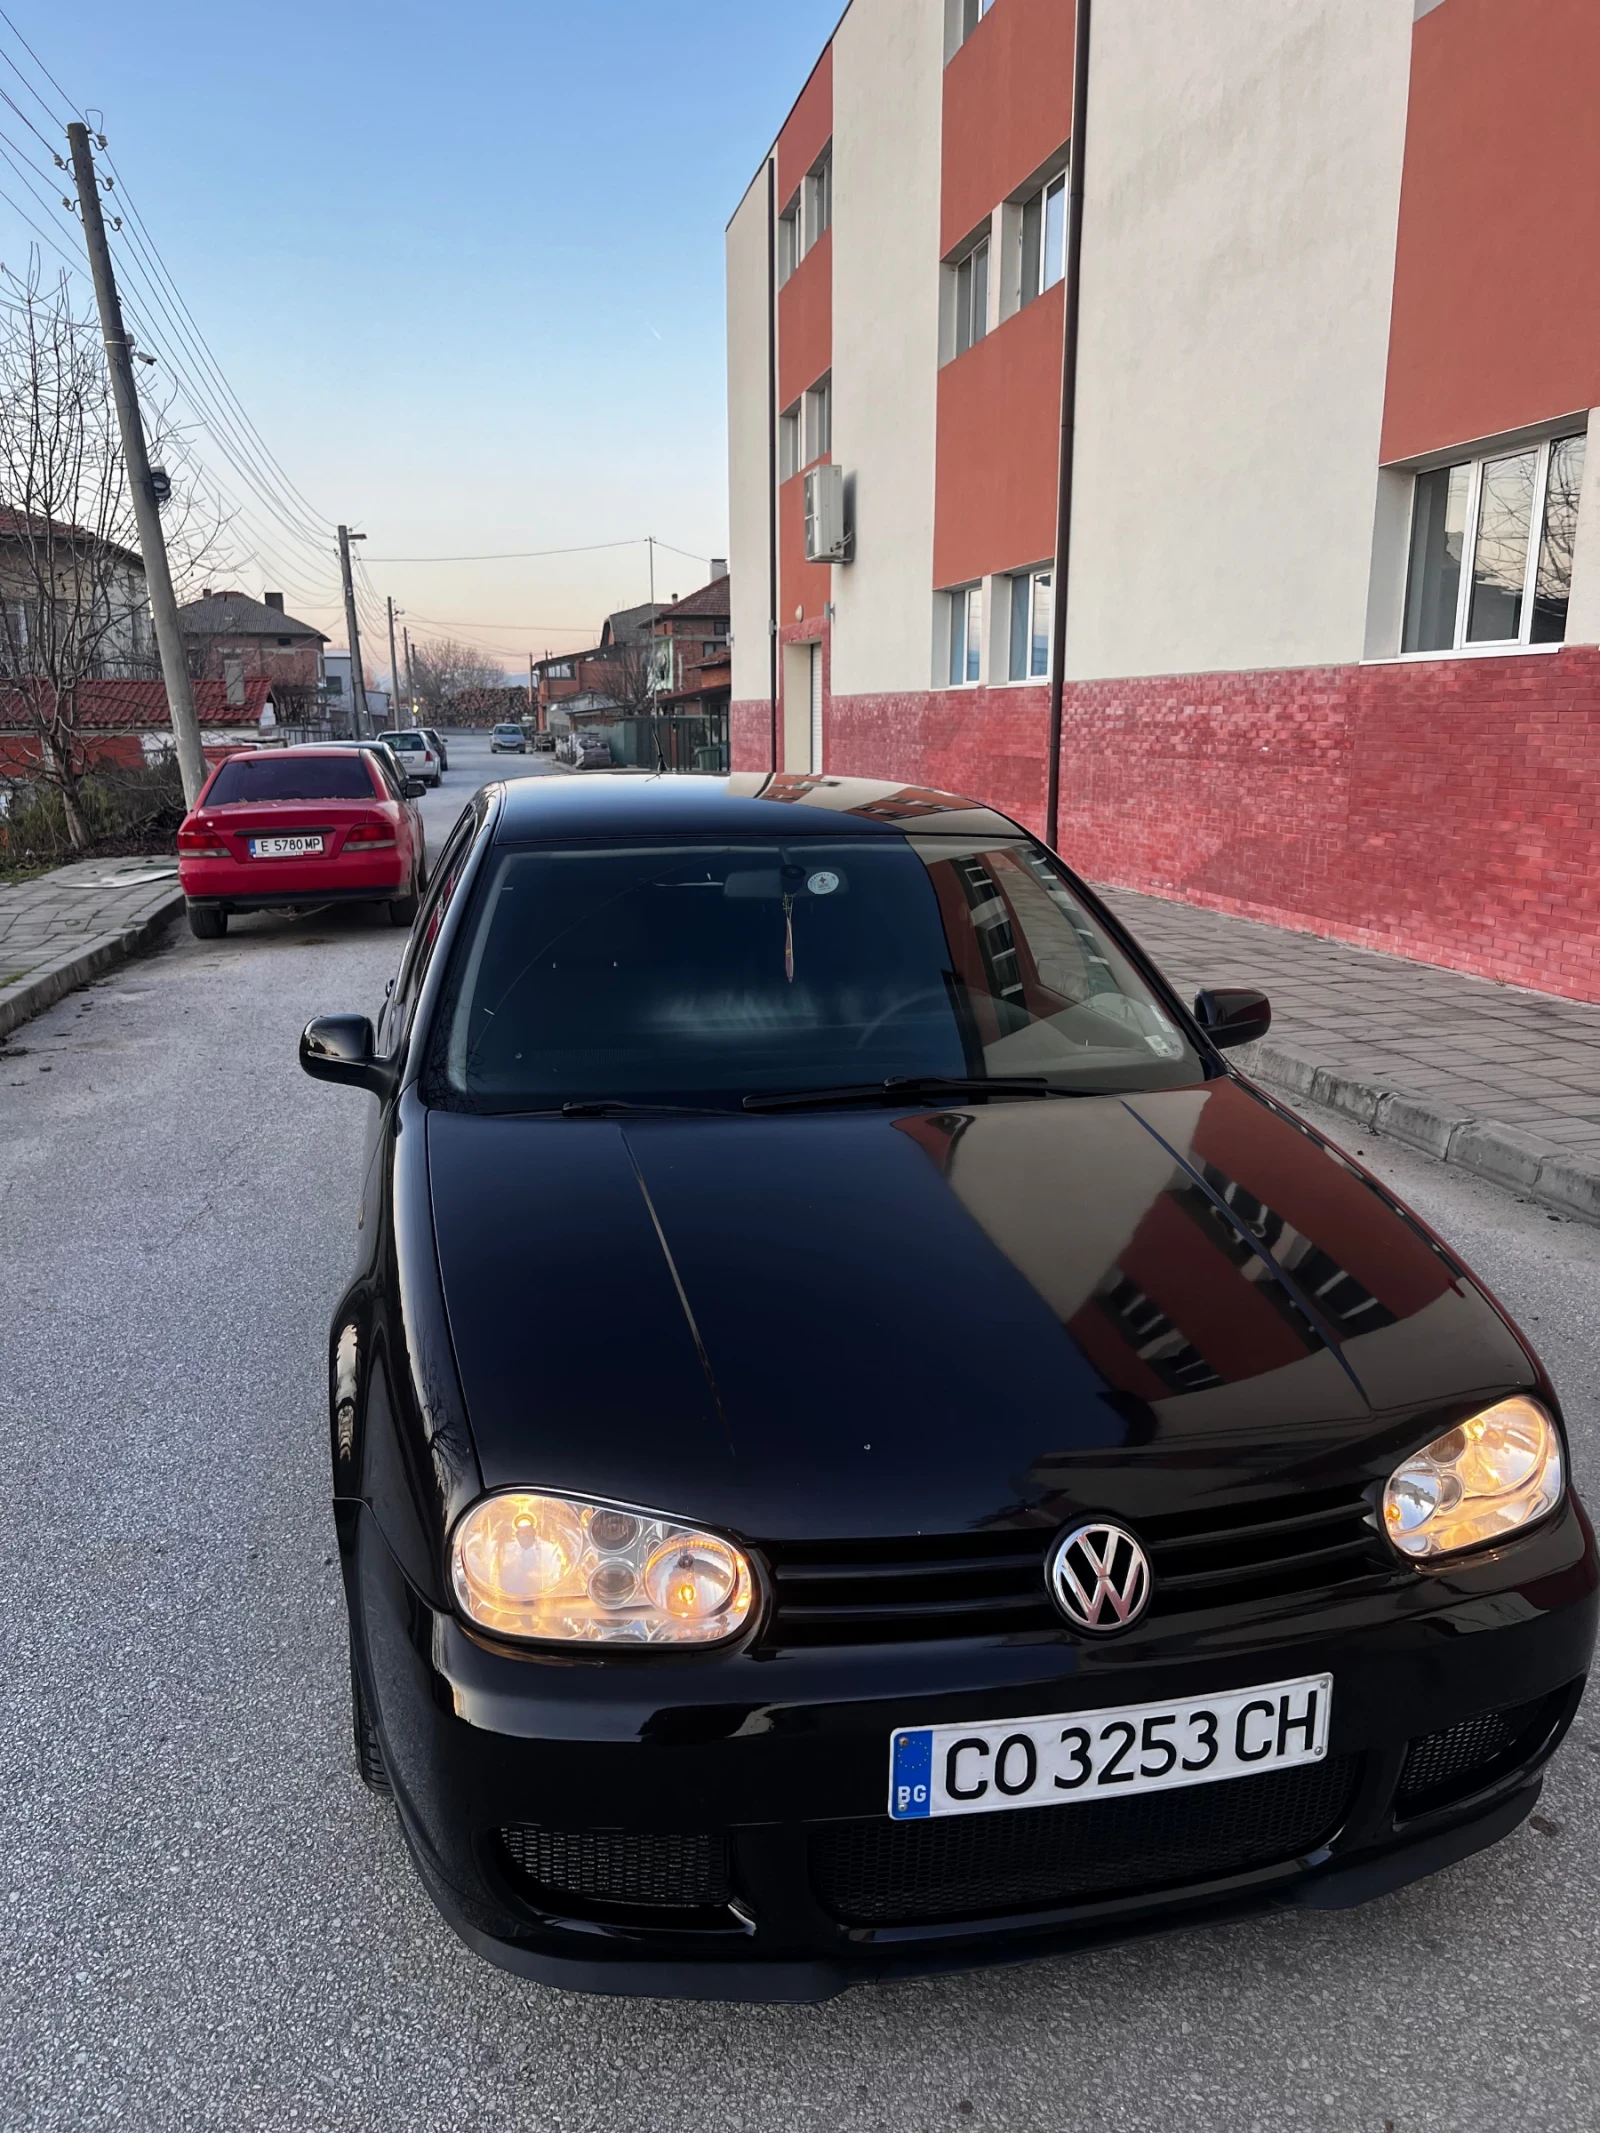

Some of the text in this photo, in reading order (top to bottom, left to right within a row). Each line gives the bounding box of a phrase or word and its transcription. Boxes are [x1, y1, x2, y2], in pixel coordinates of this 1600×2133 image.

[260, 840, 269, 852] E
[274, 839, 303, 851] 5780
[304, 838, 320, 850] MP
[1052, 1523, 1150, 1631] VW
[944, 1689, 1319, 1801] CO 3253 CH
[897, 1784, 927, 1804] BG
